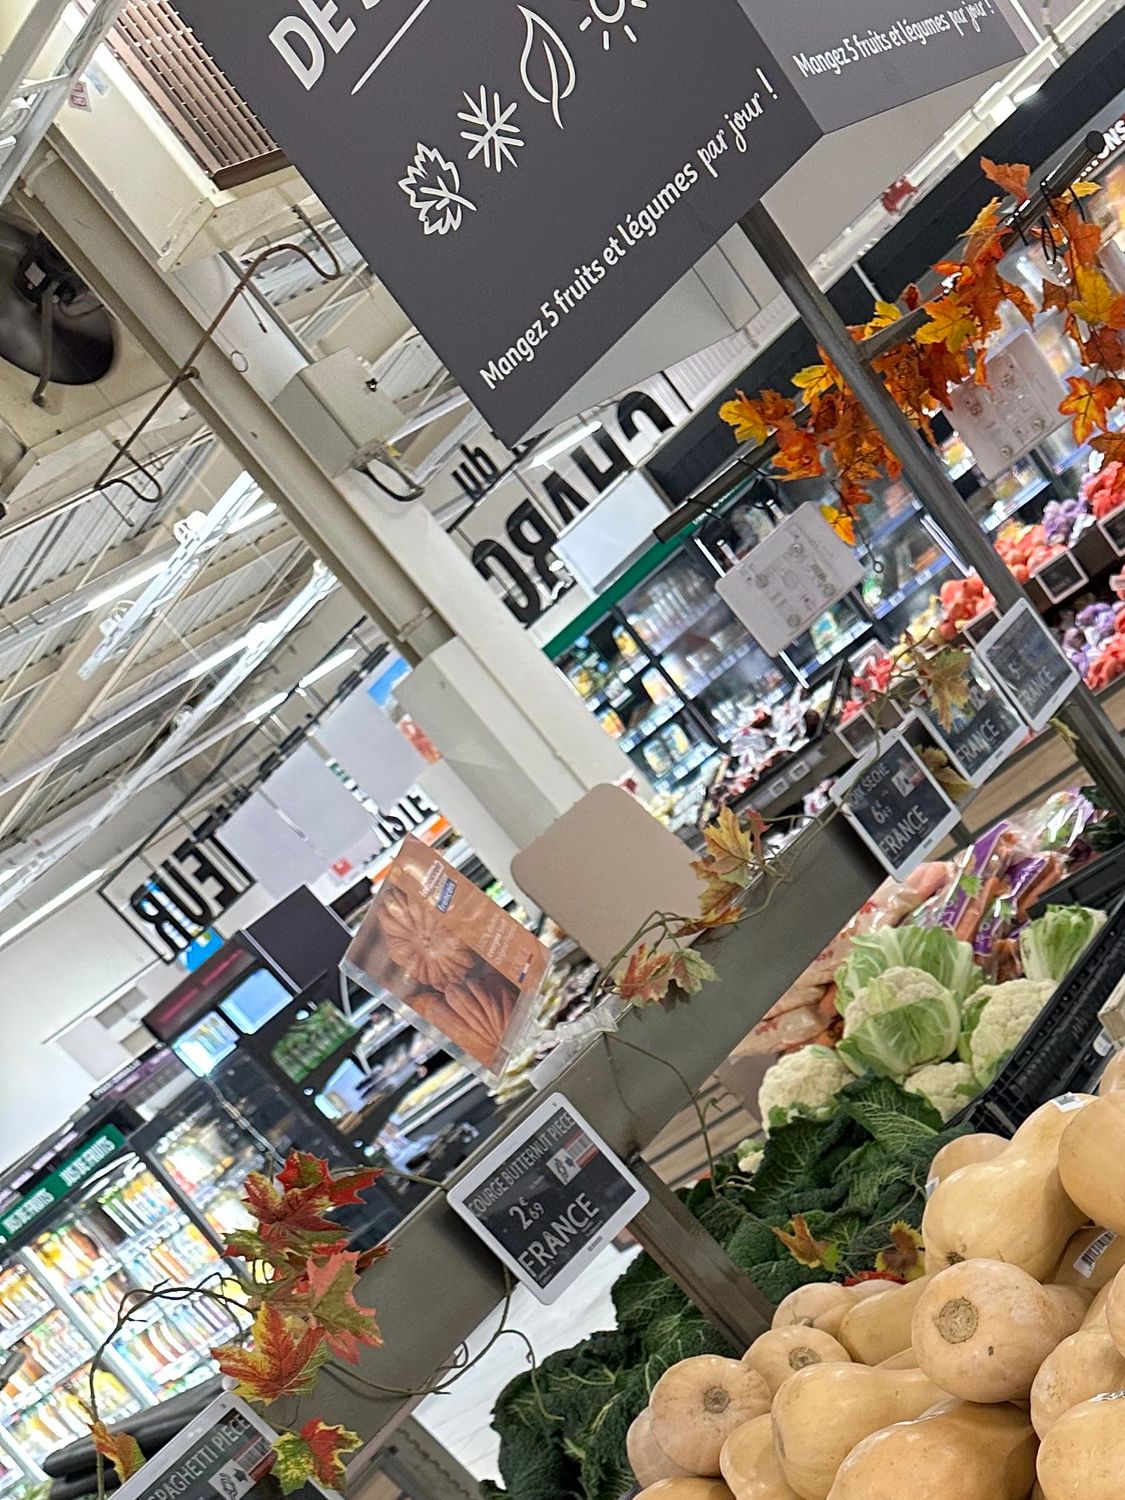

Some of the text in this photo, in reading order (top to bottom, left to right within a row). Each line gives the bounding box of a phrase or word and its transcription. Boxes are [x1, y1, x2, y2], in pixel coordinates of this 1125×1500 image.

[268, 0, 357, 91] DE
[792, 42, 850, 78] Mangez
[842, 37, 860, 62] 5
[853, 28, 892, 58] fruits
[888, 23, 904, 47] et
[900, 12, 950, 46] légumes
[949, 8, 968, 36] par
[963, 0, 988, 33] jour
[479, 67, 778, 390] Mangez 5 fruits et légumes par jour !
[863, 762, 890, 795] SECHE
[954, 718, 1000, 764] FRANCE
[878, 804, 929, 858] FRANCE
[468, 1111, 576, 1218] COURGE BUTTERNUT PIECE
[518, 1192, 600, 1278] FRANCE
[213, 1413, 251, 1456] PIECE
